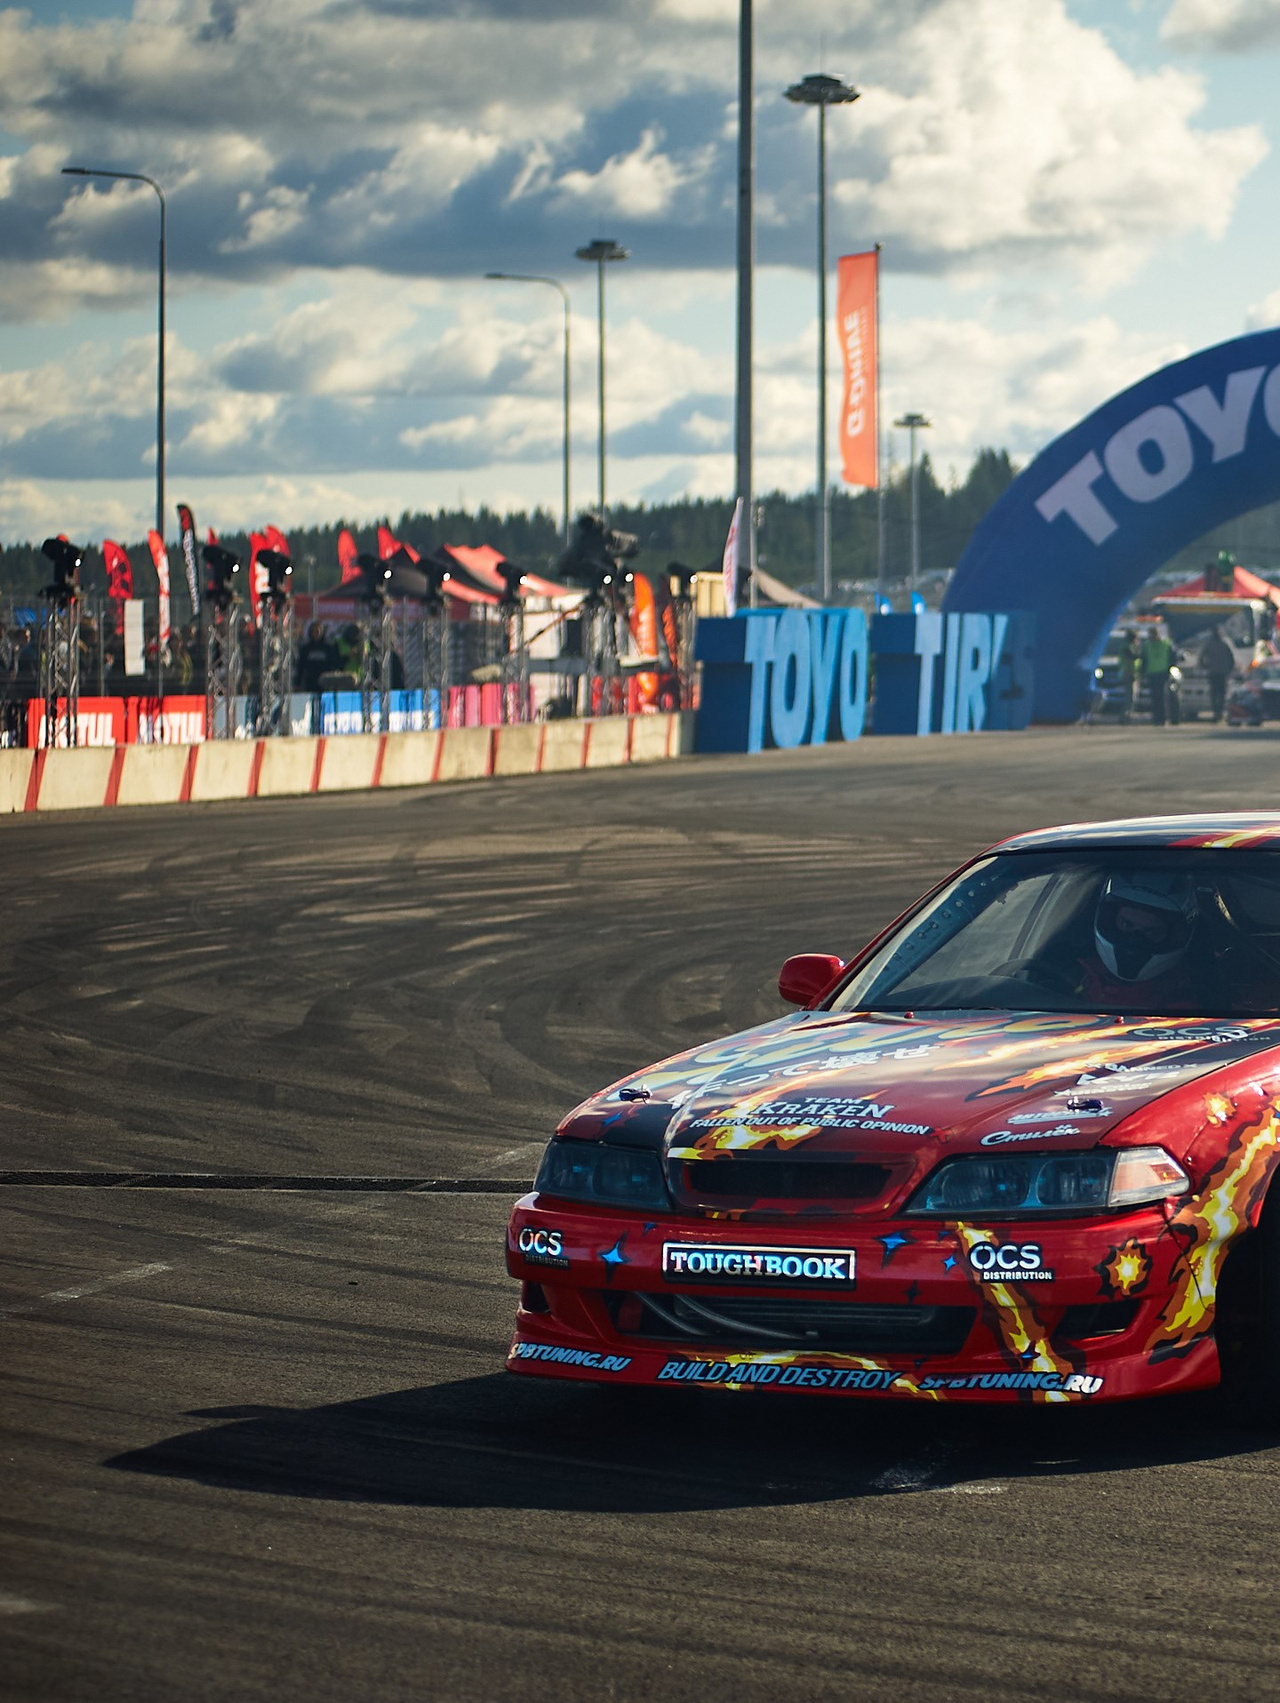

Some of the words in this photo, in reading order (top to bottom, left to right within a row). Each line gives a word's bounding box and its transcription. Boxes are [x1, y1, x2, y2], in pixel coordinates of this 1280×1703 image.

[744, 608, 867, 754] TOYO
[749, 1102, 895, 1118] KRAKEN
[804, 1097, 864, 1105] TEAM
[689, 1117, 745, 1128] FALLEN
[749, 1116, 778, 1126] OUT
[777, 1116, 799, 1125] OF
[800, 1116, 860, 1128] PUBLIC
[860, 1121, 931, 1135] OPINION
[518, 1228, 562, 1256] OCS
[524, 1254, 570, 1268] DISTRIBUTION
[670, 1251, 846, 1279] TOUGHBOOK
[970, 1245, 1041, 1270] OCS
[983, 1270, 1053, 1281] DISTRIBUTION
[509, 1342, 632, 1372] SPBTUNING.RU
[657, 1361, 728, 1382] BUILD
[729, 1364, 780, 1384] AND
[779, 1367, 901, 1390] DESTROY
[920, 1371, 1105, 1395] SPBTUNING.RU
